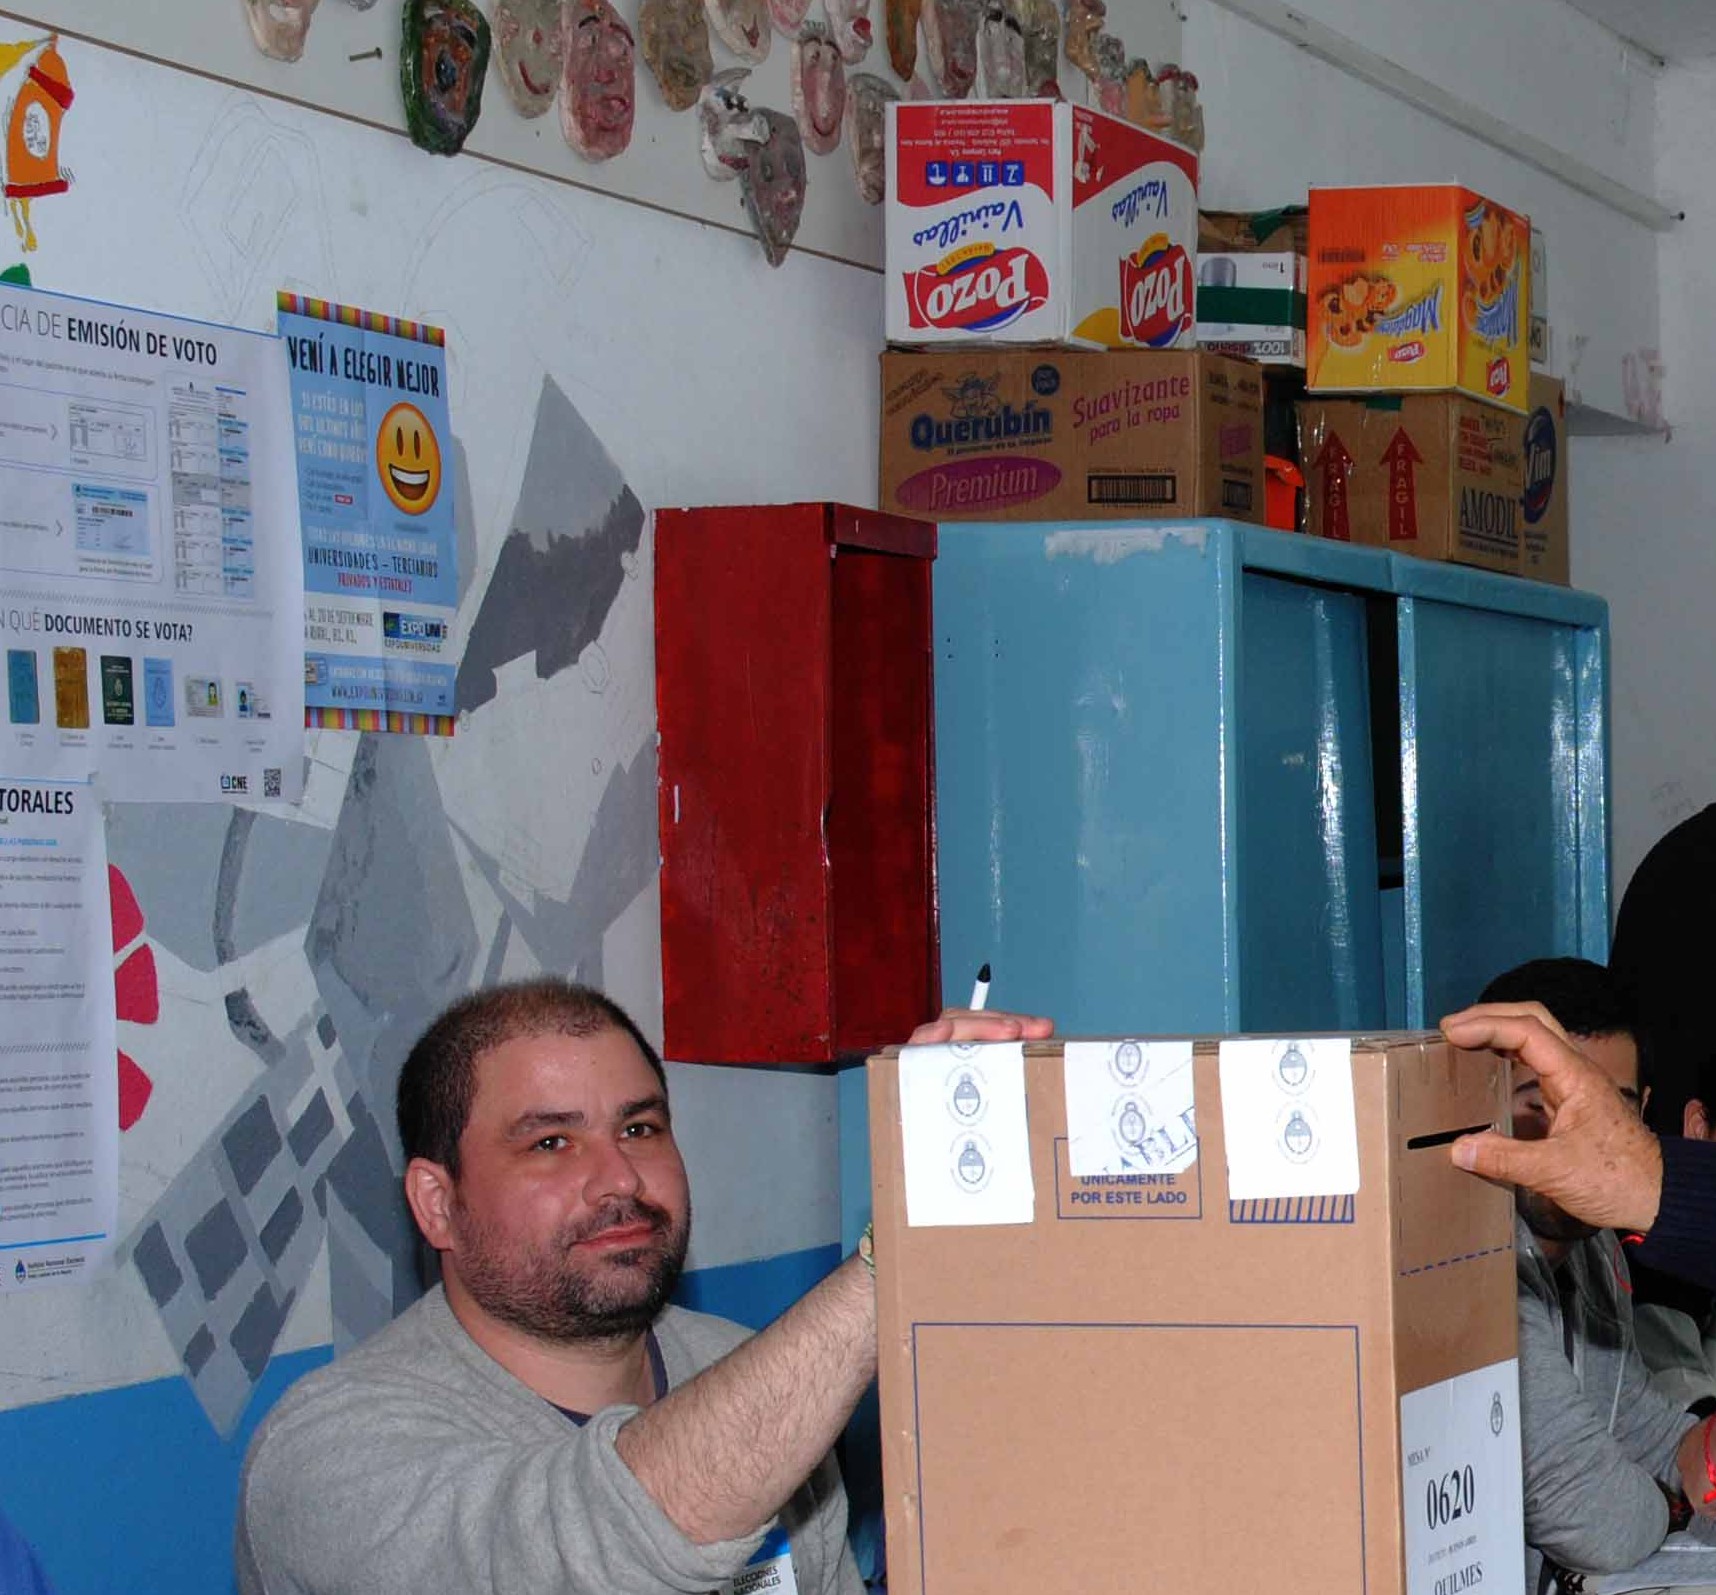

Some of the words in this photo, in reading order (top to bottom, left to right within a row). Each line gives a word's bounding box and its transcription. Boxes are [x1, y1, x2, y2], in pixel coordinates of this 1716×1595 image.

[37, 311, 61, 339] DE
[67, 317, 141, 353] EMISIÓN
[146, 331, 168, 357] DE
[173, 337, 217, 366] VOTO
[287, 331, 323, 374] VENÍ
[330, 344, 338, 376] A
[344, 347, 392, 388] ELEGIR
[396, 359, 440, 398] MEJOR
[1072, 371, 1190, 429] Suavizante
[1089, 419, 1120, 446] para
[1127, 410, 1140, 428] la
[1147, 402, 1180, 426] ropa
[929, 462, 1038, 512] Premium
[1396, 443, 1409, 535] FRAGIL
[308, 546, 379, 571] UNIVERSIDADES
[44, 613, 132, 638] DOCUMENTO
[136, 622, 150, 639] SE
[154, 623, 193, 642] VOTA?
[0, 788, 74, 815] TORALES
[1071, 1192, 1102, 1204] POR
[1106, 1192, 1143, 1204] ESTE
[1147, 1191, 1187, 1204] LADO
[1426, 1464, 1475, 1530] 0620
[1434, 1561, 1483, 1595] QUILMES
